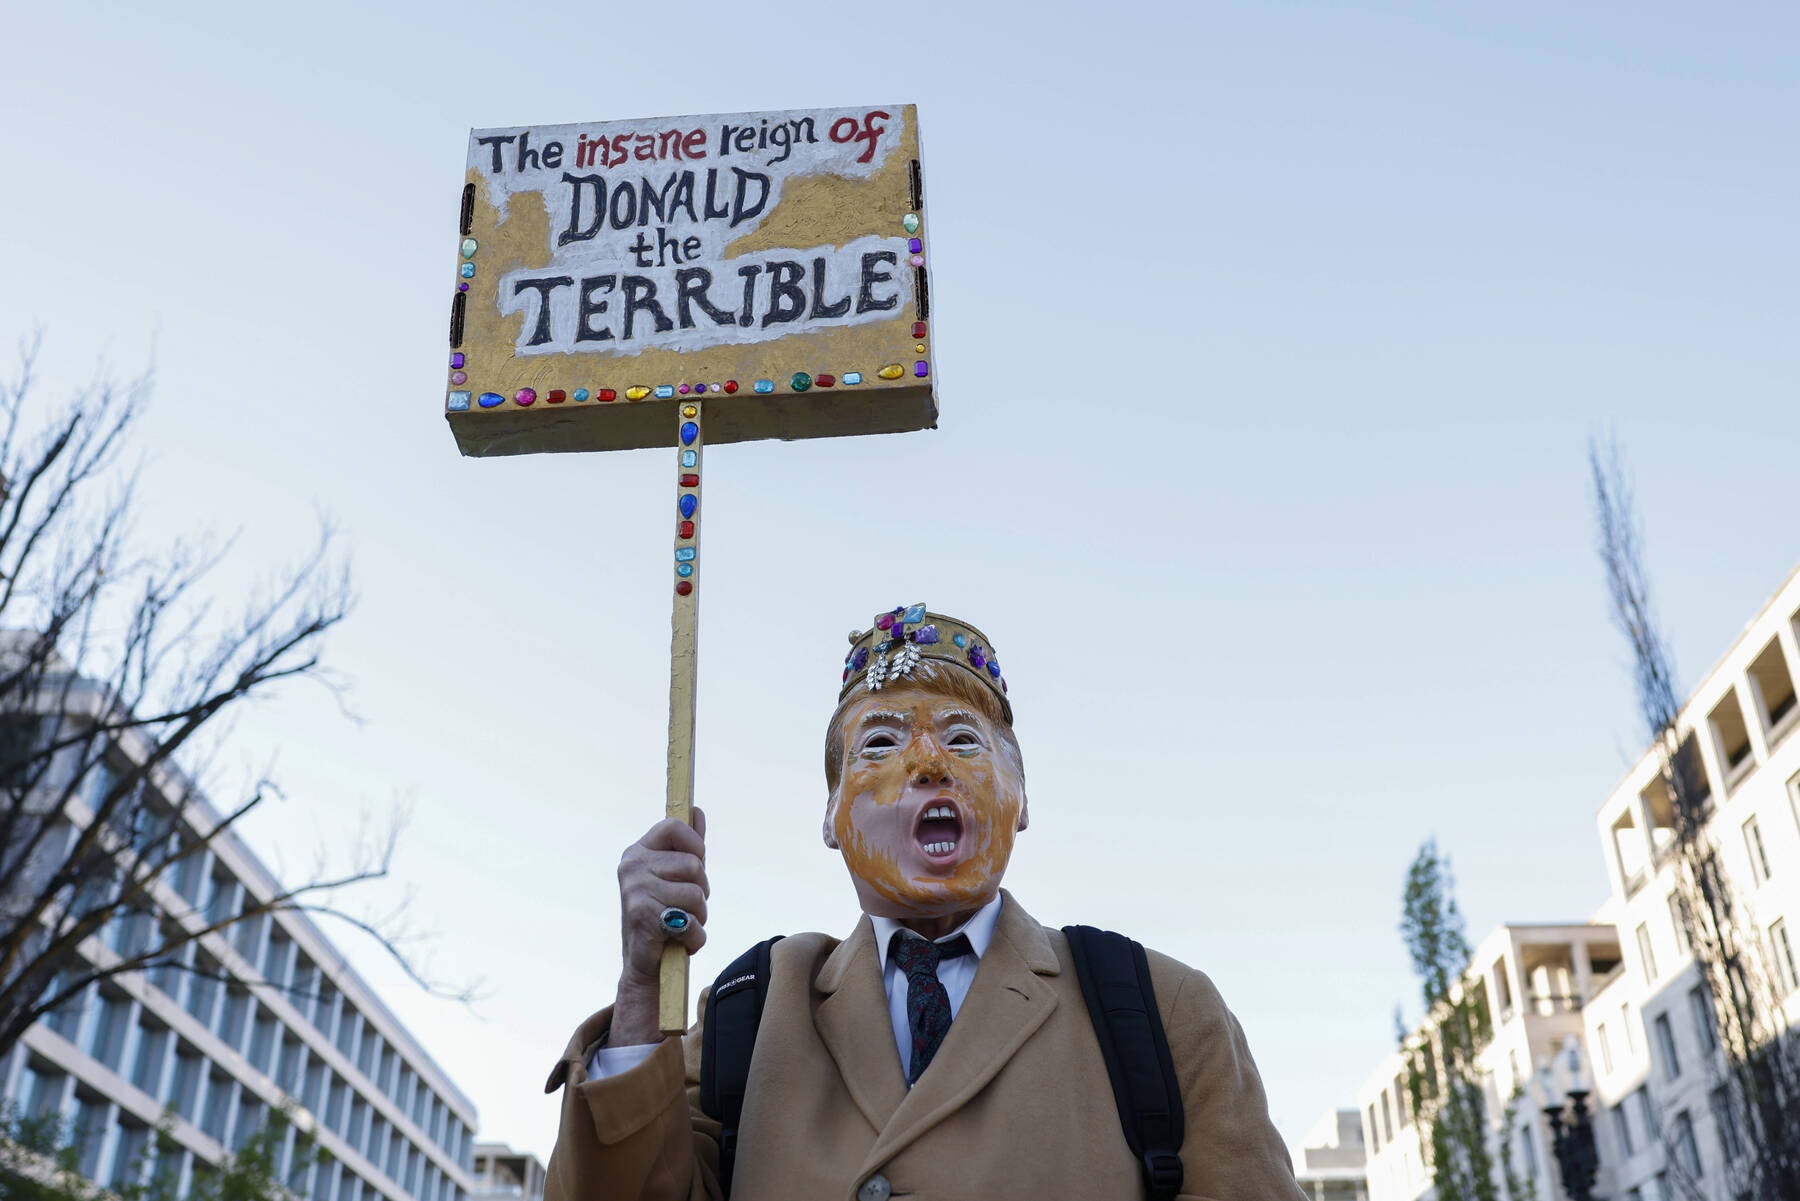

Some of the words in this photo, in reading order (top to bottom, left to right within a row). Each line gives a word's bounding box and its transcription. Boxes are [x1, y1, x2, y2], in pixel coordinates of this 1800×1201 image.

[479, 132, 563, 173] The
[576, 128, 707, 168] insane
[720, 116, 817, 166] reign
[829, 111, 890, 163] of
[558, 168, 771, 246] DONALD
[629, 228, 702, 268] the
[514, 251, 898, 346] TERRIBLE
